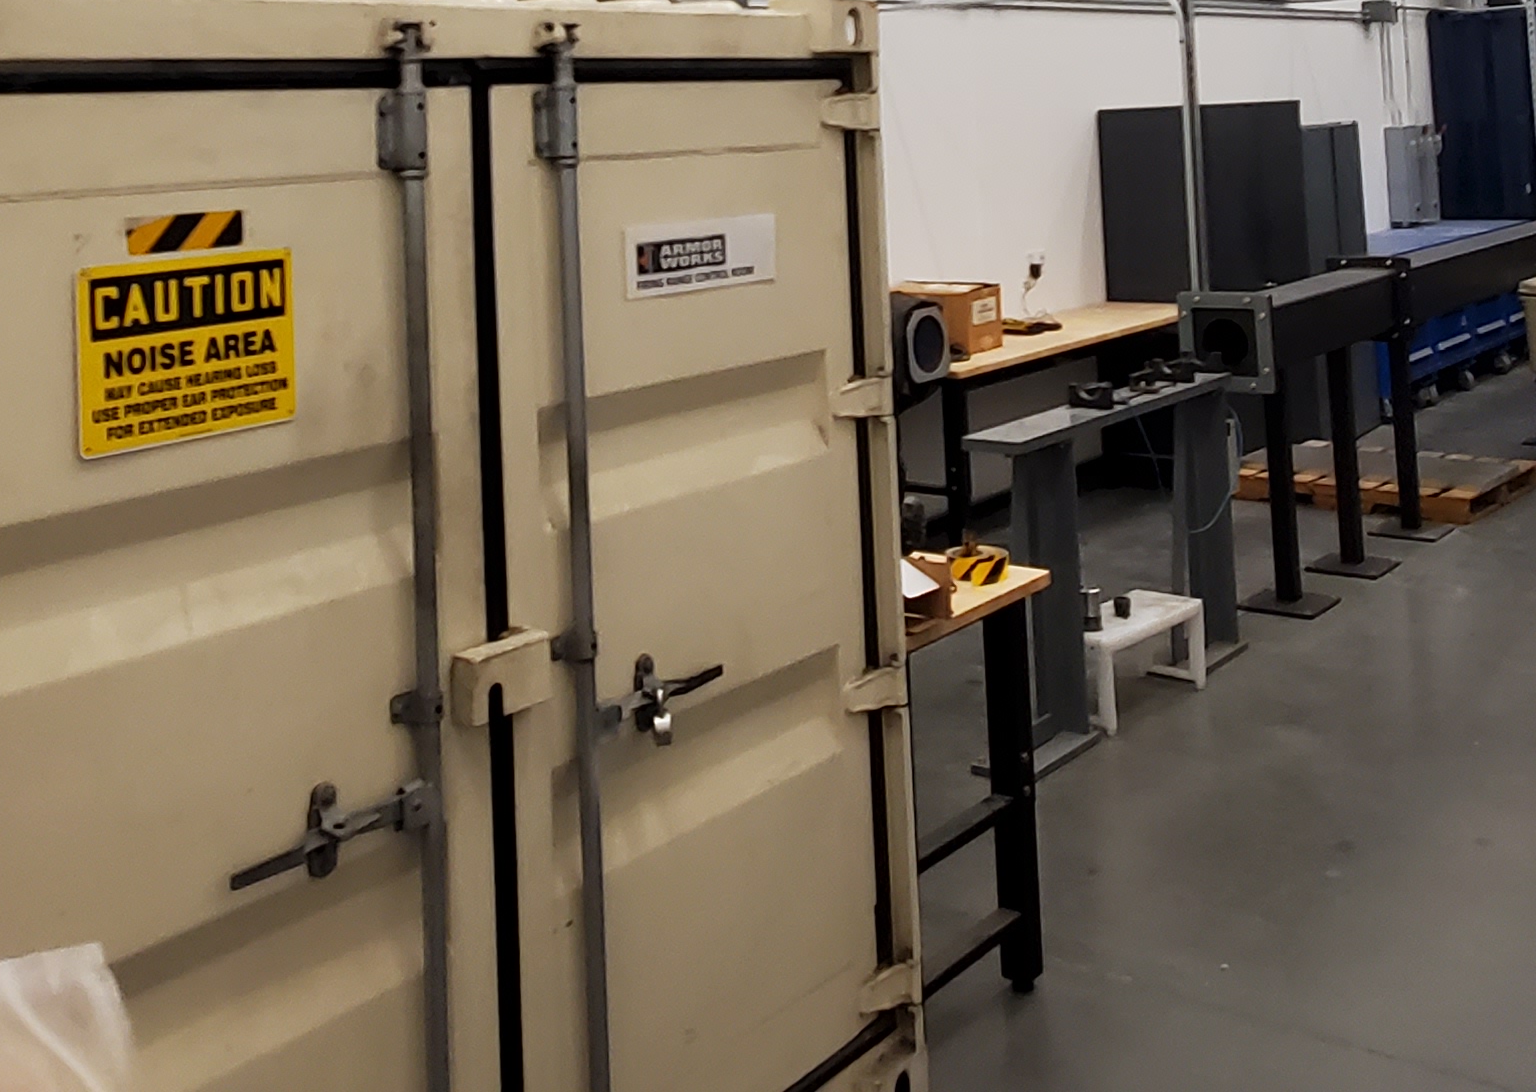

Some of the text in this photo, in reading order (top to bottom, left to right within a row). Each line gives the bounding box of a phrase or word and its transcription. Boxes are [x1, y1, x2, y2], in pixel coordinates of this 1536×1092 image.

[660, 239, 722, 256] ARMOR
[660, 251, 723, 269] WORKS
[94, 268, 282, 330] CAUTION
[103, 329, 277, 379] NOISE AREA
[92, 377, 289, 424] USE PROPER EAR PROTECTION
[104, 361, 277, 402] MAY CAUSE HEARING LOSS
[107, 397, 278, 441] FOR EXTENDED EXPOSURE
